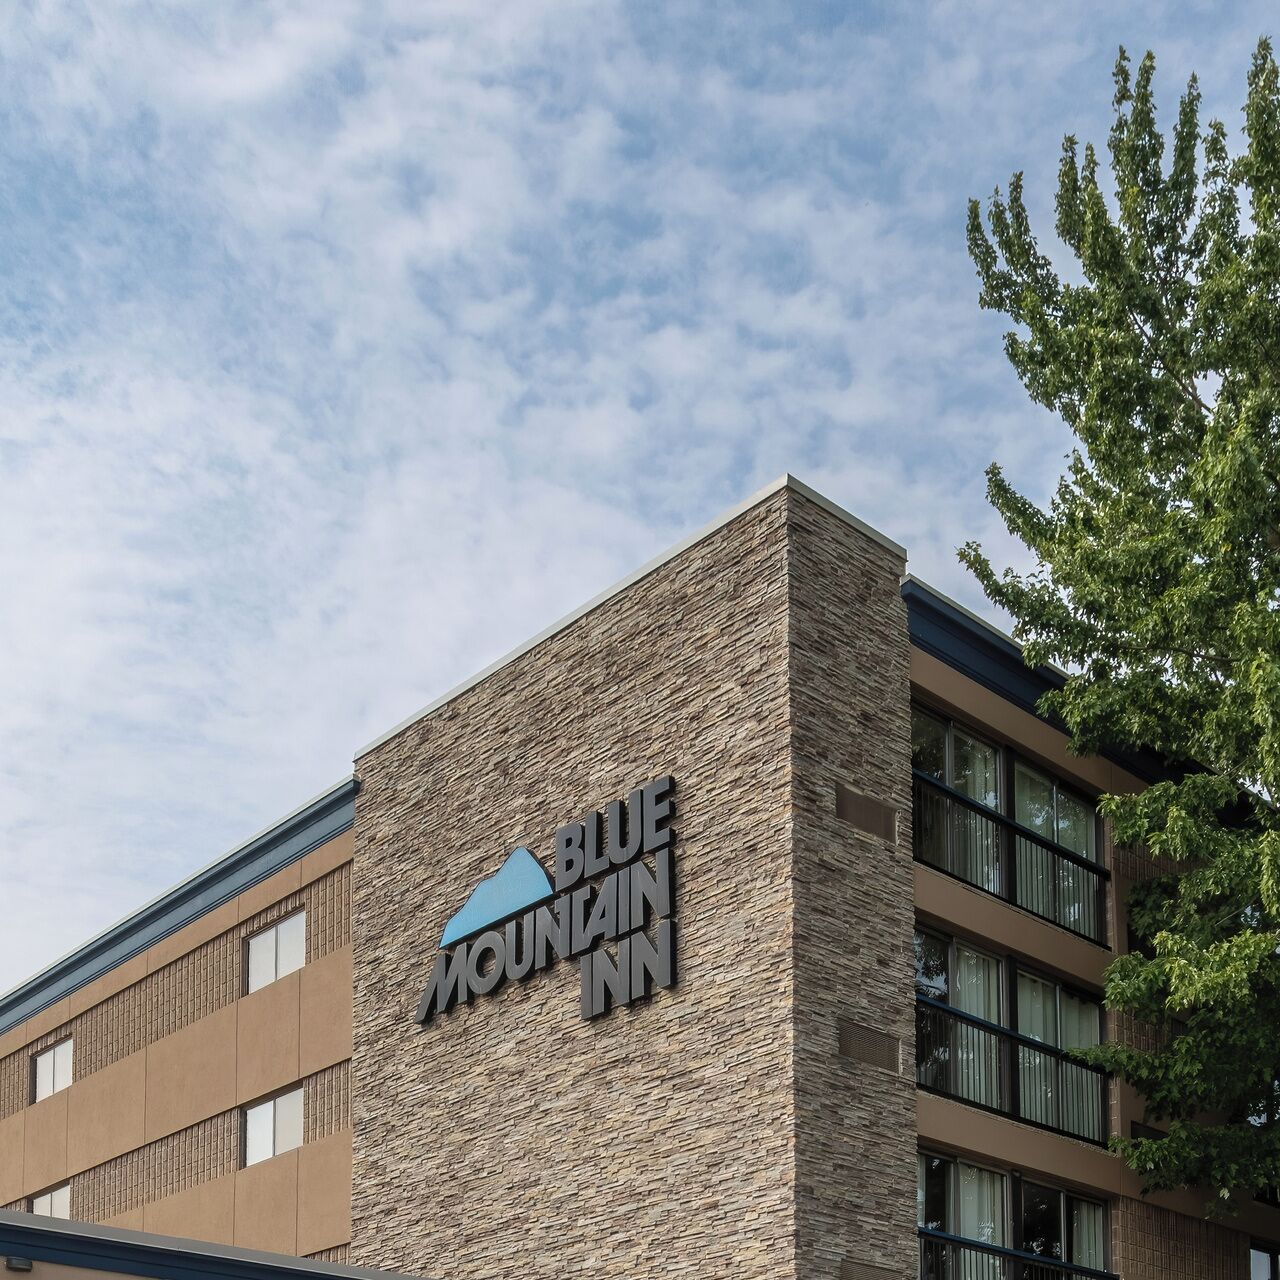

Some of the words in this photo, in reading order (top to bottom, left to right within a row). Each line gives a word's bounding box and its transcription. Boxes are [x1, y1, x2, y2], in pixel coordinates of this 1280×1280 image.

[556, 775, 674, 891] BLUE
[415, 848, 675, 1025] MOUNTAIN
[580, 918, 676, 1021] INN
